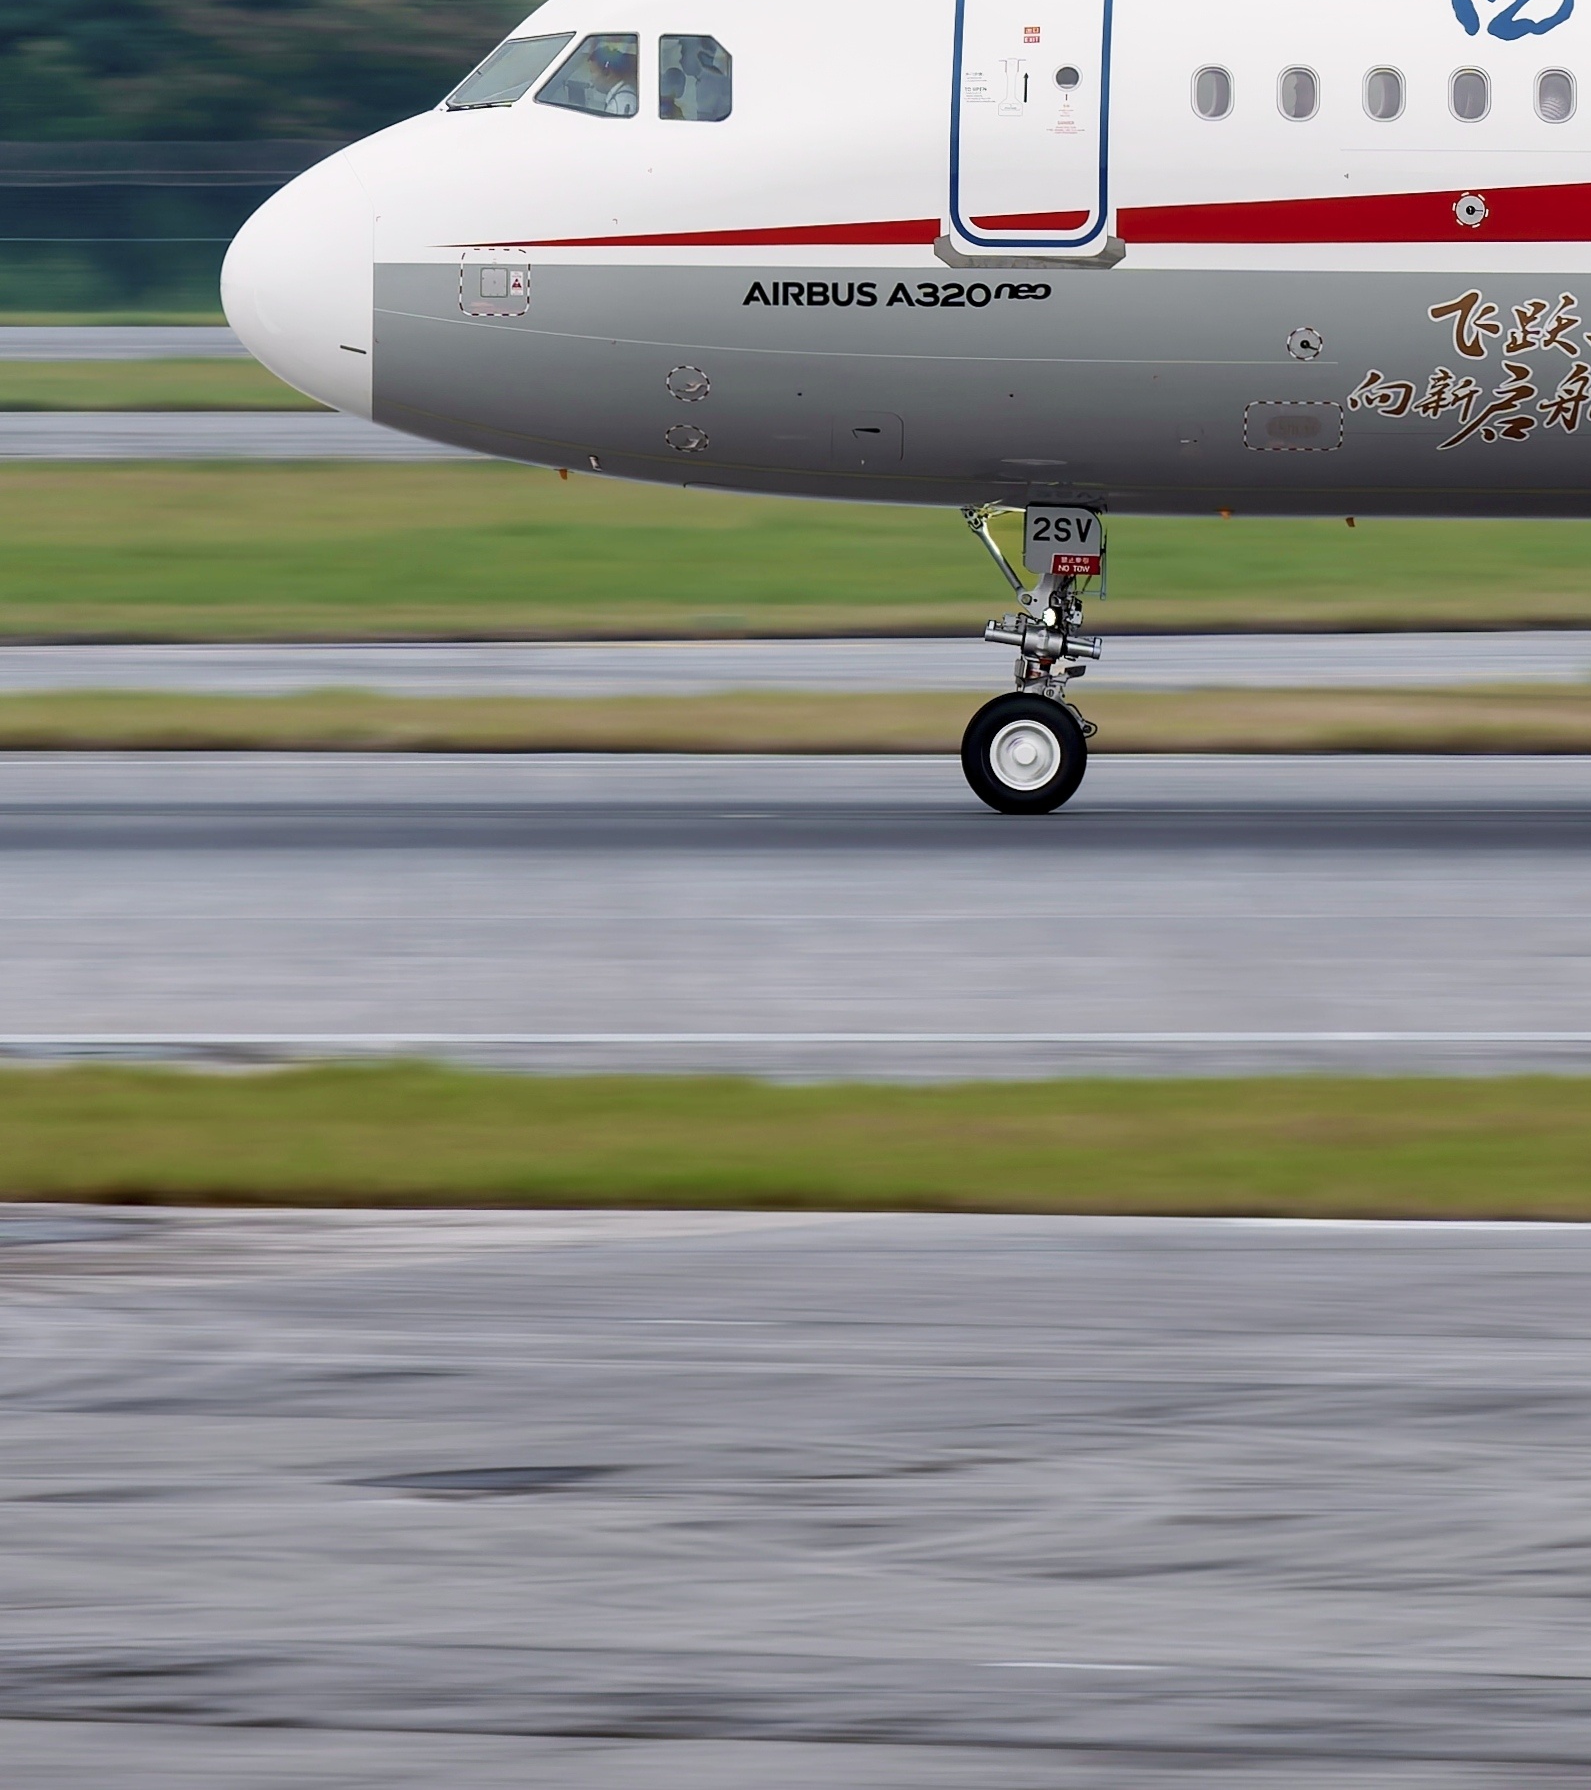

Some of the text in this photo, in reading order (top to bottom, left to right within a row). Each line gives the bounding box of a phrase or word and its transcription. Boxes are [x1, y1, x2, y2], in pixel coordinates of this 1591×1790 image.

[742, 281, 878, 307] AIRBUS
[1032, 516, 1093, 543] 2SV
[1057, 564, 1090, 573] NO TOW
